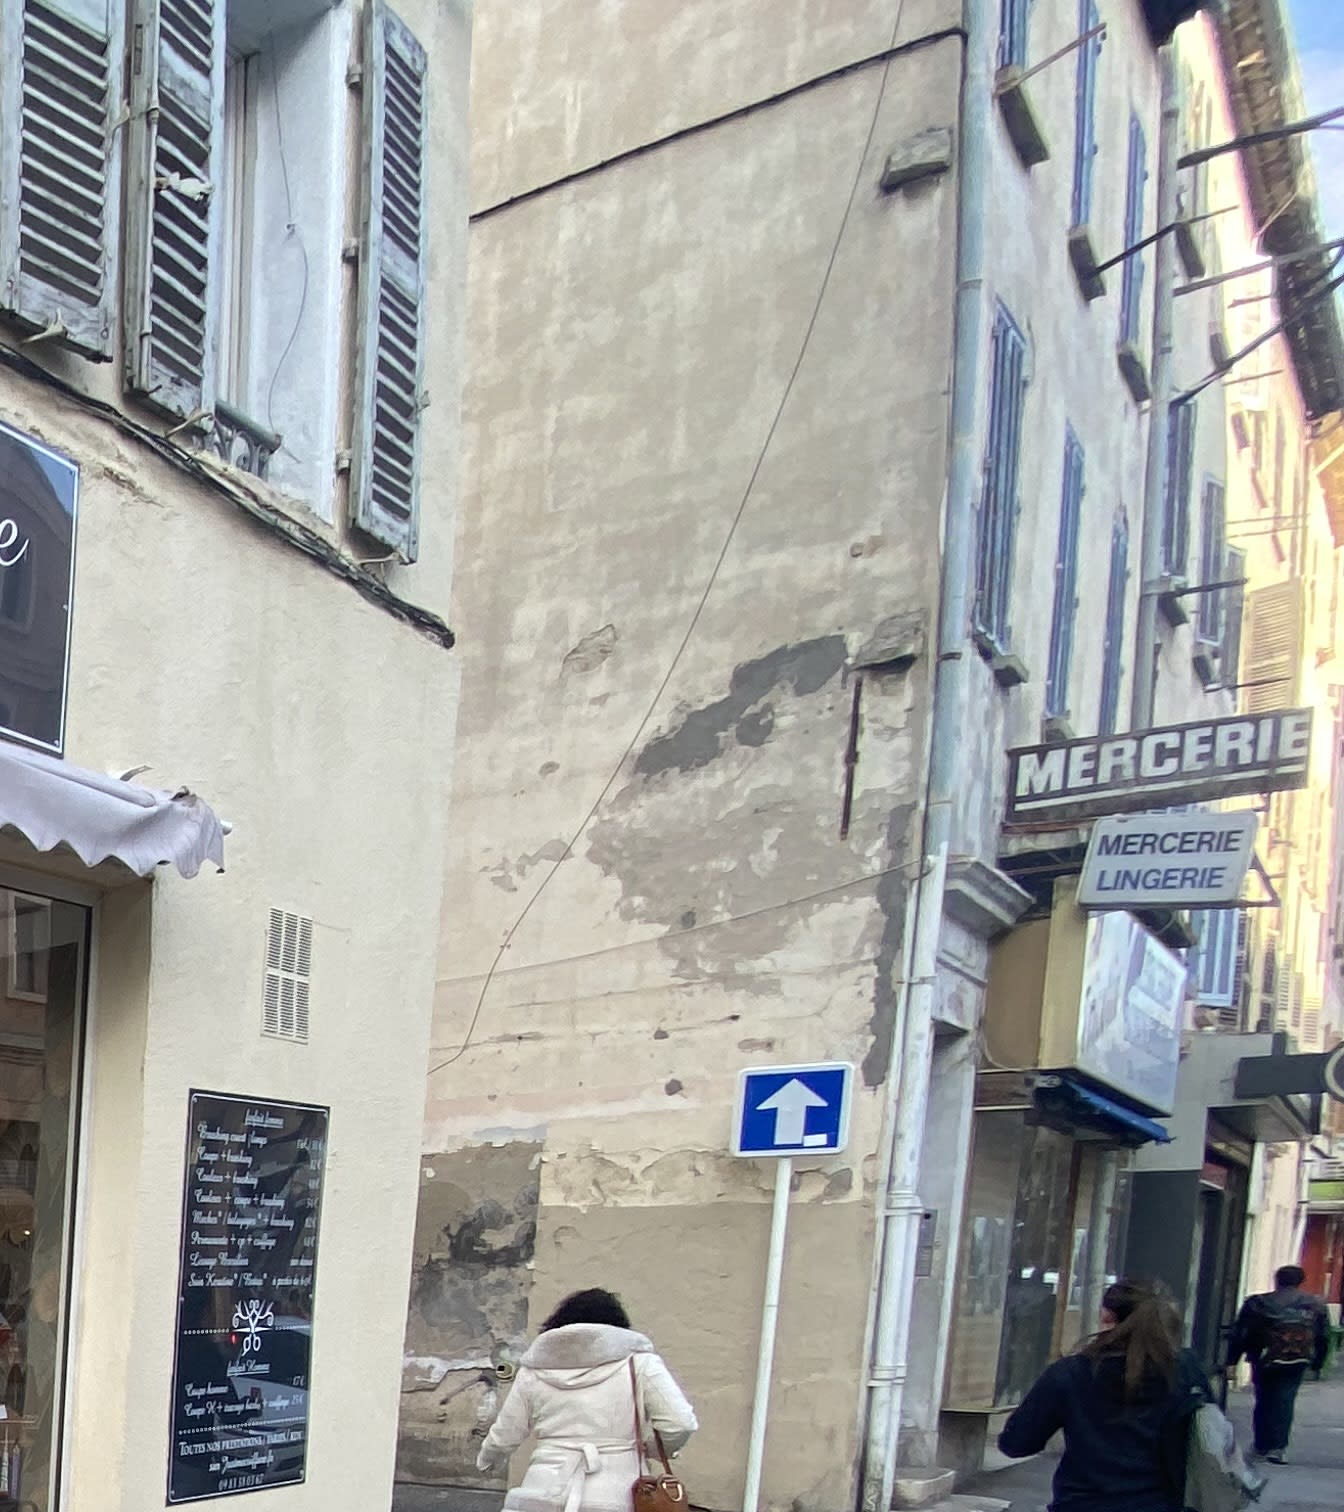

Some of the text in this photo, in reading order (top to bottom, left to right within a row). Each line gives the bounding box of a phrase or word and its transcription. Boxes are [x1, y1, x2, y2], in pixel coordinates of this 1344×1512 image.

[1016, 715, 1311, 797] MERCERIE
[1097, 829, 1244, 856] MERCERIE
[1096, 867, 1226, 891] LINGERIE
